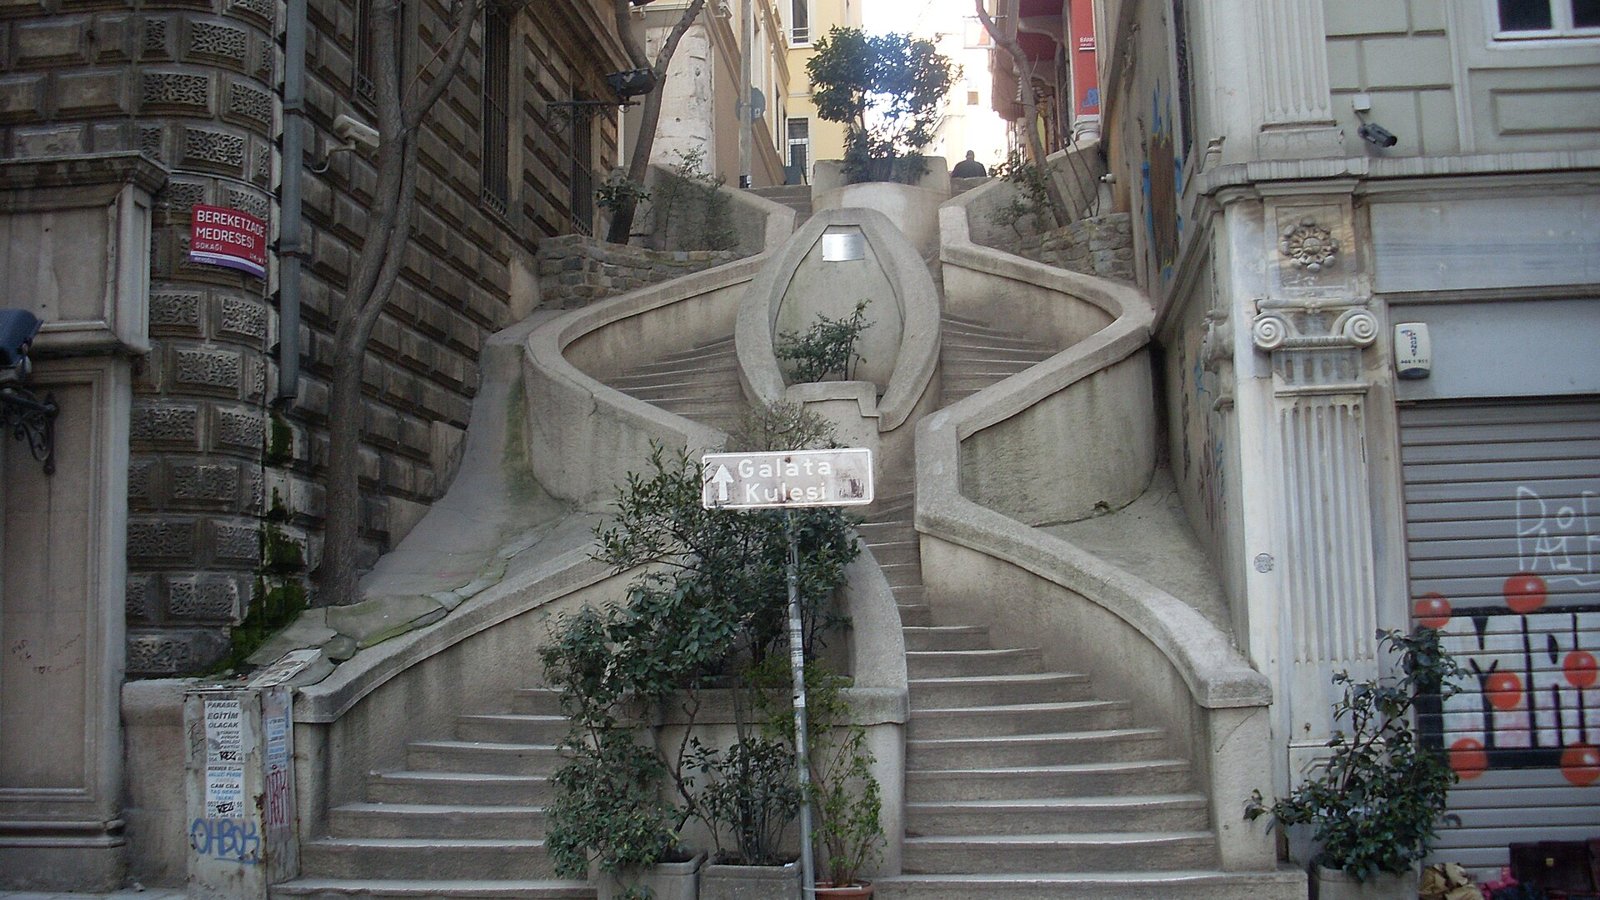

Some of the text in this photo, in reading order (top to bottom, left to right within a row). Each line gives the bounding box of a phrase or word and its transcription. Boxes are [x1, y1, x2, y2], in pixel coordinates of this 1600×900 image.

[197, 210, 264, 238] BEREKETZADE
[738, 458, 832, 479] Galata
[745, 482, 827, 502] Kulesi
